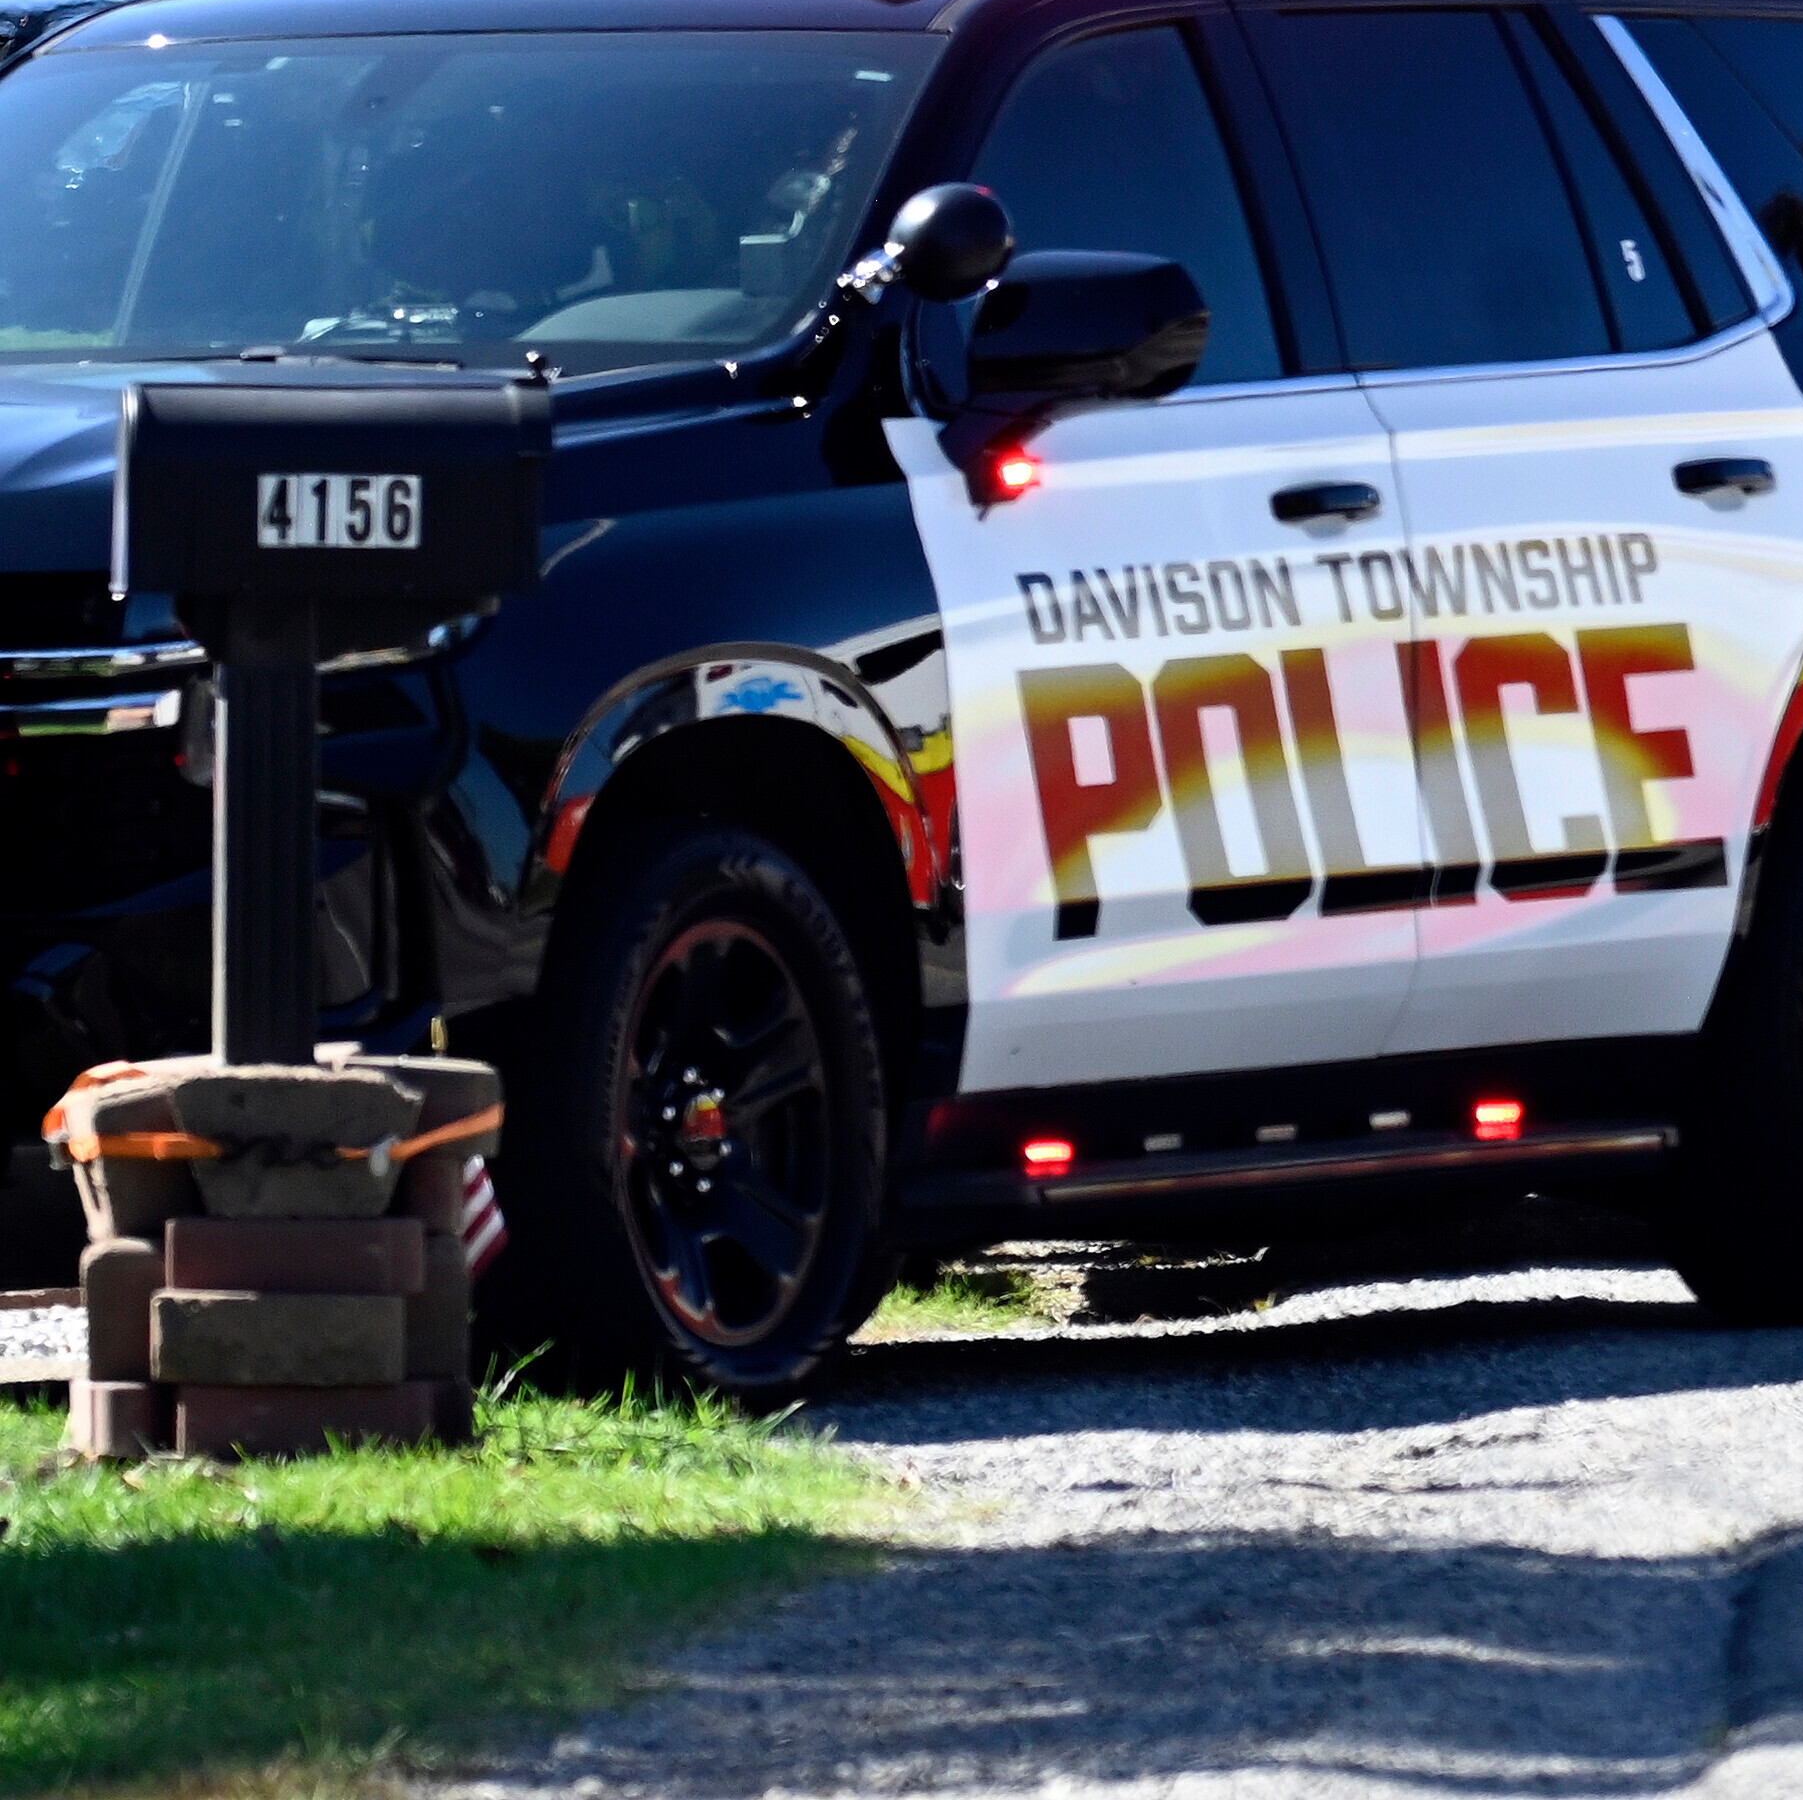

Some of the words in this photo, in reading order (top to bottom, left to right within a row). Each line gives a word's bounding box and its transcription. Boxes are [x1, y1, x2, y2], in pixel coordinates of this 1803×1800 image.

[1619, 238, 1647, 283] 5
[264, 478, 412, 543] 4156
[1014, 554, 1302, 646] DAVISON
[1315, 532, 1660, 625] TOWNSHIP
[1015, 622, 1730, 942] POLICE
